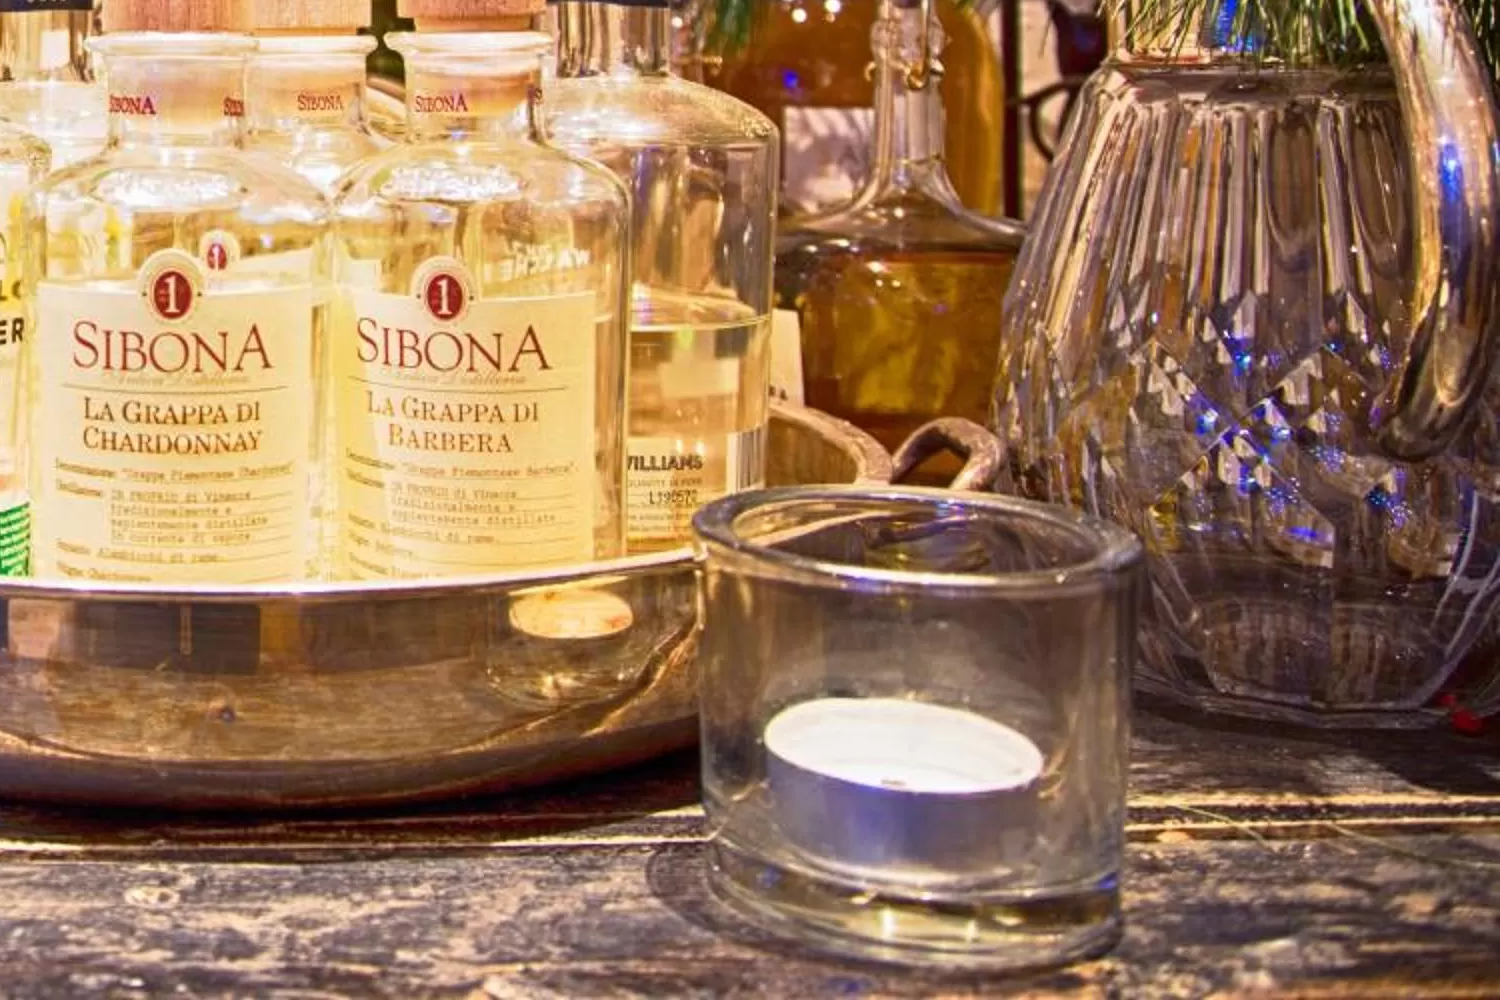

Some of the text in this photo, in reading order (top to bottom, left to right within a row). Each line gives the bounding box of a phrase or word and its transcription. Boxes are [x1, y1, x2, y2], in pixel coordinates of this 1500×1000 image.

[415, 94, 468, 113] SIBONA
[72, 320, 274, 373] SIBONA
[356, 316, 553, 373] SIBONA
[84, 396, 261, 425] LA GRAPPA DI
[366, 391, 539, 424] LA GRAPPA DI
[82, 426, 263, 455] CHARDONNAY
[388, 422, 514, 453] BARBERA
